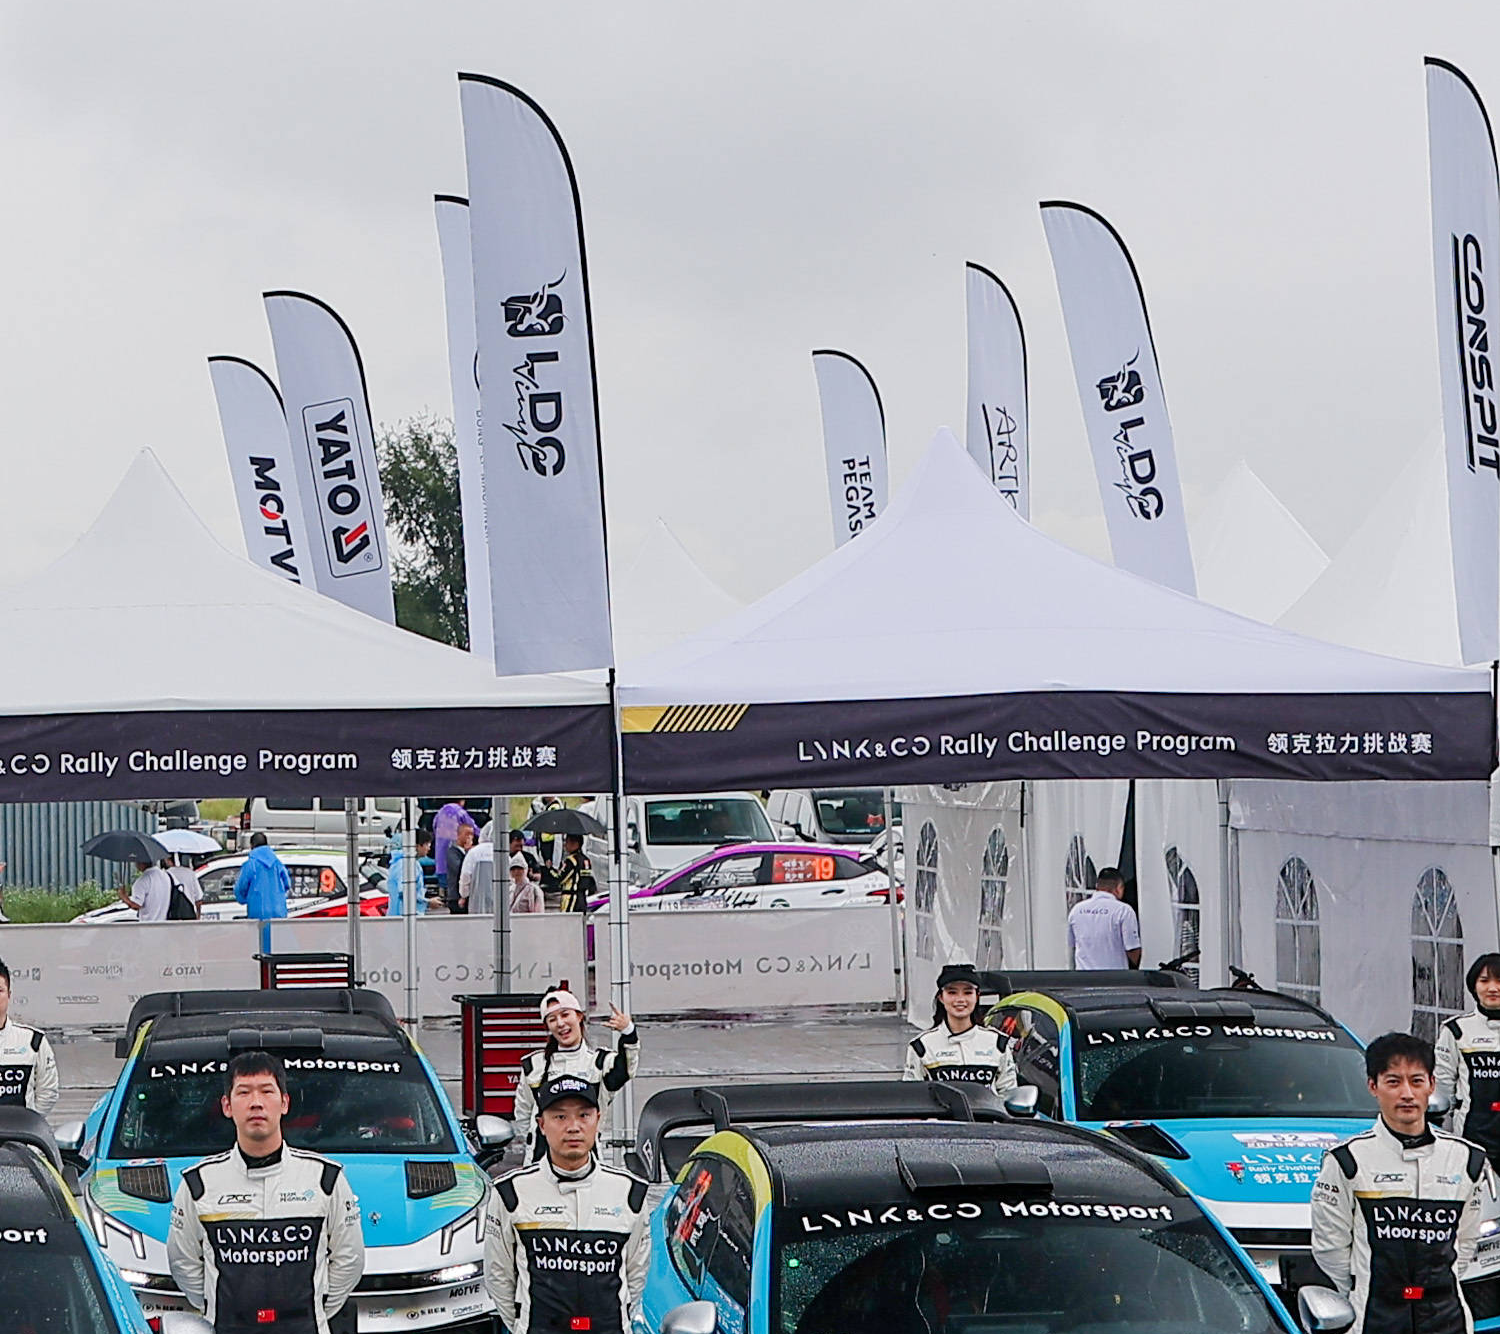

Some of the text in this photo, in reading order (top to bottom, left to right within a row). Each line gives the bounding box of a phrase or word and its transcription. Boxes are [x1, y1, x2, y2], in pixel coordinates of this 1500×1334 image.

[525, 352, 566, 477] LDC
[316, 410, 360, 515] YATO
[1121, 416, 1162, 521] LDC
[843, 458, 863, 539] PEGAS
[858, 455, 876, 519] TEAM
[249, 456, 301, 584] MOTV
[798, 731, 1236, 761] LYNK&CO Rally Challenge Program
[1267, 732, 1433, 754] 领克拉力挑战赛
[60, 752, 119, 778] Rally
[129, 749, 248, 773] Challenge
[258, 750, 358, 773] Program
[392, 746, 558, 769] 领克拉力挑战赛
[814, 857, 834, 879] 19
[320, 868, 335, 893] 9
[1087, 1026, 1336, 1045] LYNK&CO Motorsport
[283, 1058, 401, 1073] Motorsport
[1248, 1163, 1320, 1173] Rally Challen
[802, 1199, 1174, 1231] LYNK&CO Motorsport
[1374, 1206, 1457, 1223] LYNK&CO
[217, 1225, 312, 1243] LYNK&CO
[219, 1246, 310, 1266] Motorsport
[533, 1238, 618, 1255] LYNK&CO
[536, 1256, 616, 1274] Motorsport
